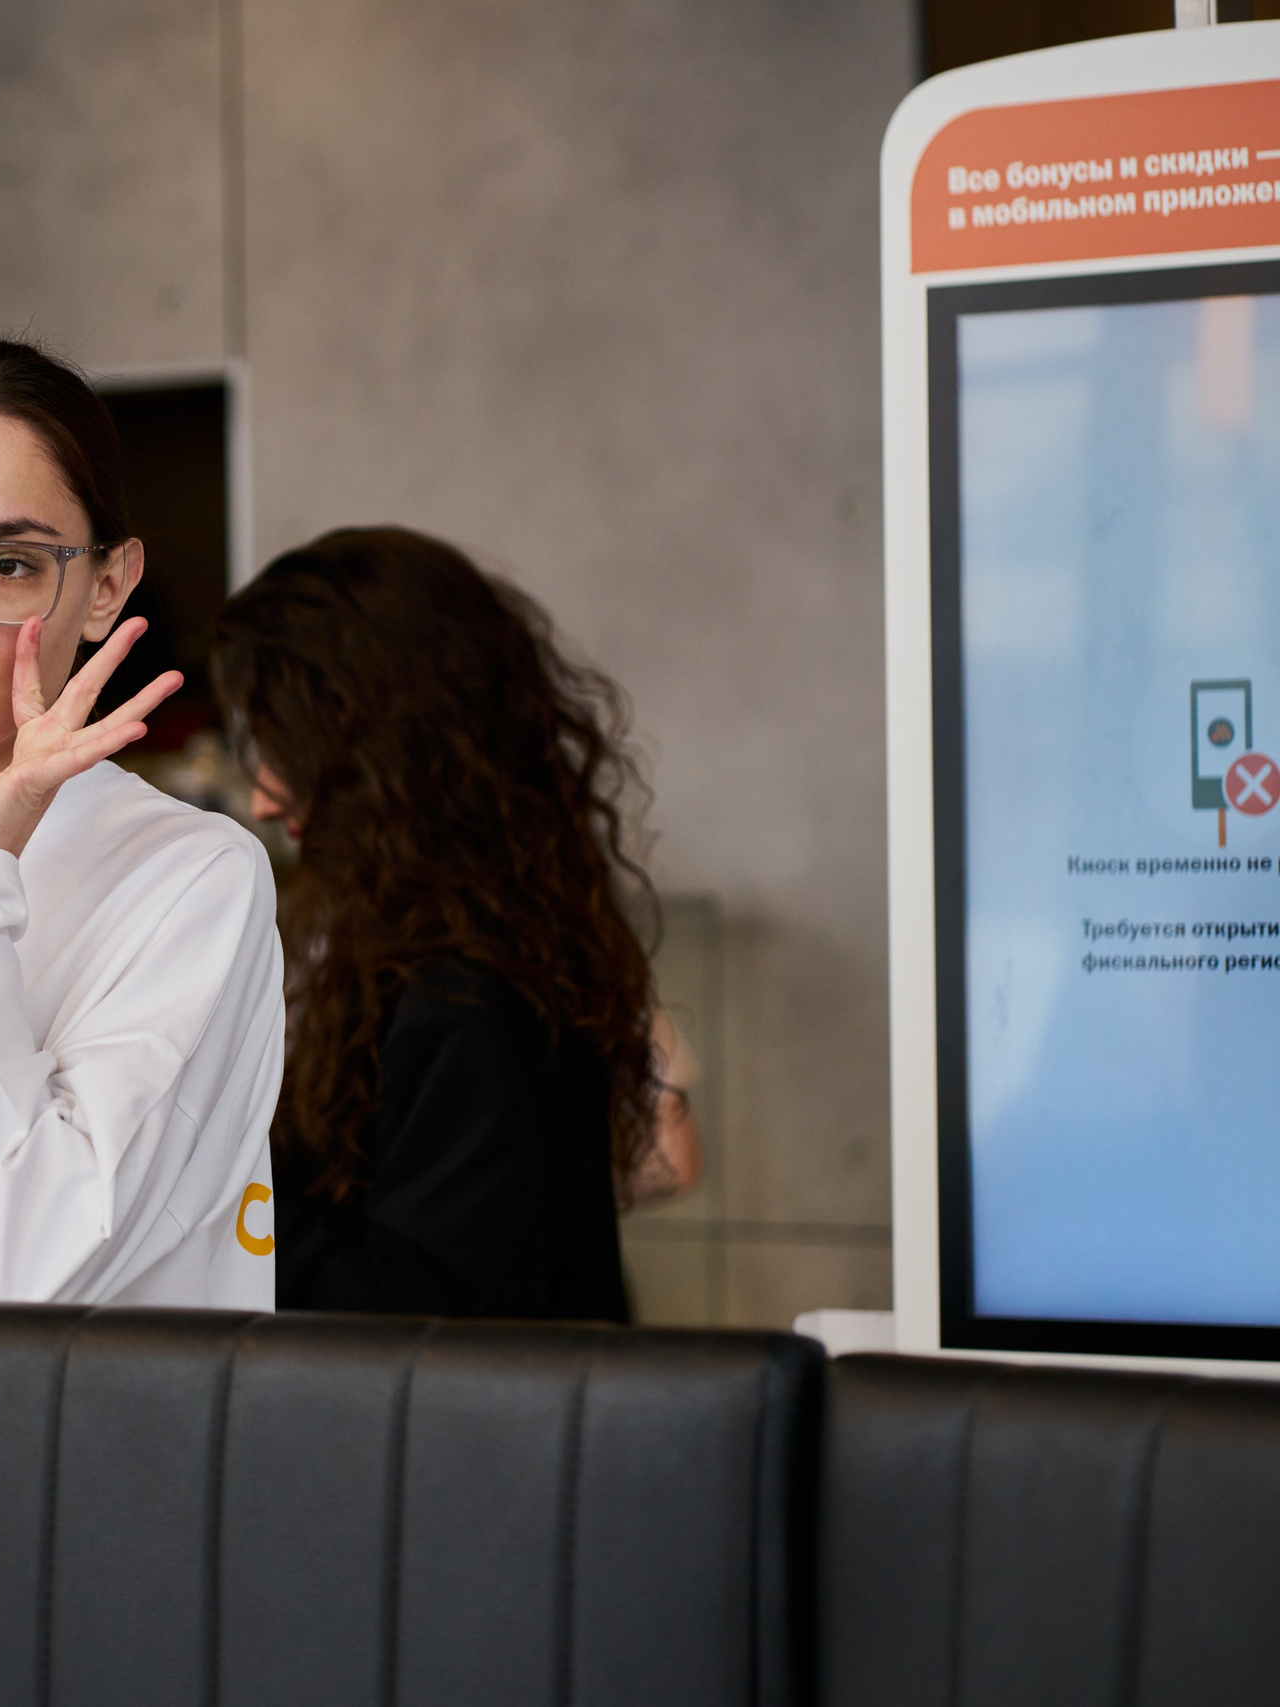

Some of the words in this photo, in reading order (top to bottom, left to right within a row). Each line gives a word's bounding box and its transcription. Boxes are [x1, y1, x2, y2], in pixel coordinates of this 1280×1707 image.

[948, 166, 1001, 196] Все
[1006, 157, 1114, 191] бонусы
[1120, 156, 1138, 180] и
[1144, 147, 1249, 177] скидки
[948, 204, 966, 230] в
[972, 192, 1137, 229] мобильном
[1067, 855, 1130, 875] Киоск
[1136, 857, 1242, 877] временно
[1247, 857, 1273, 873] не
[1081, 918, 1186, 943] Требуется
[1082, 952, 1219, 974] фискального
